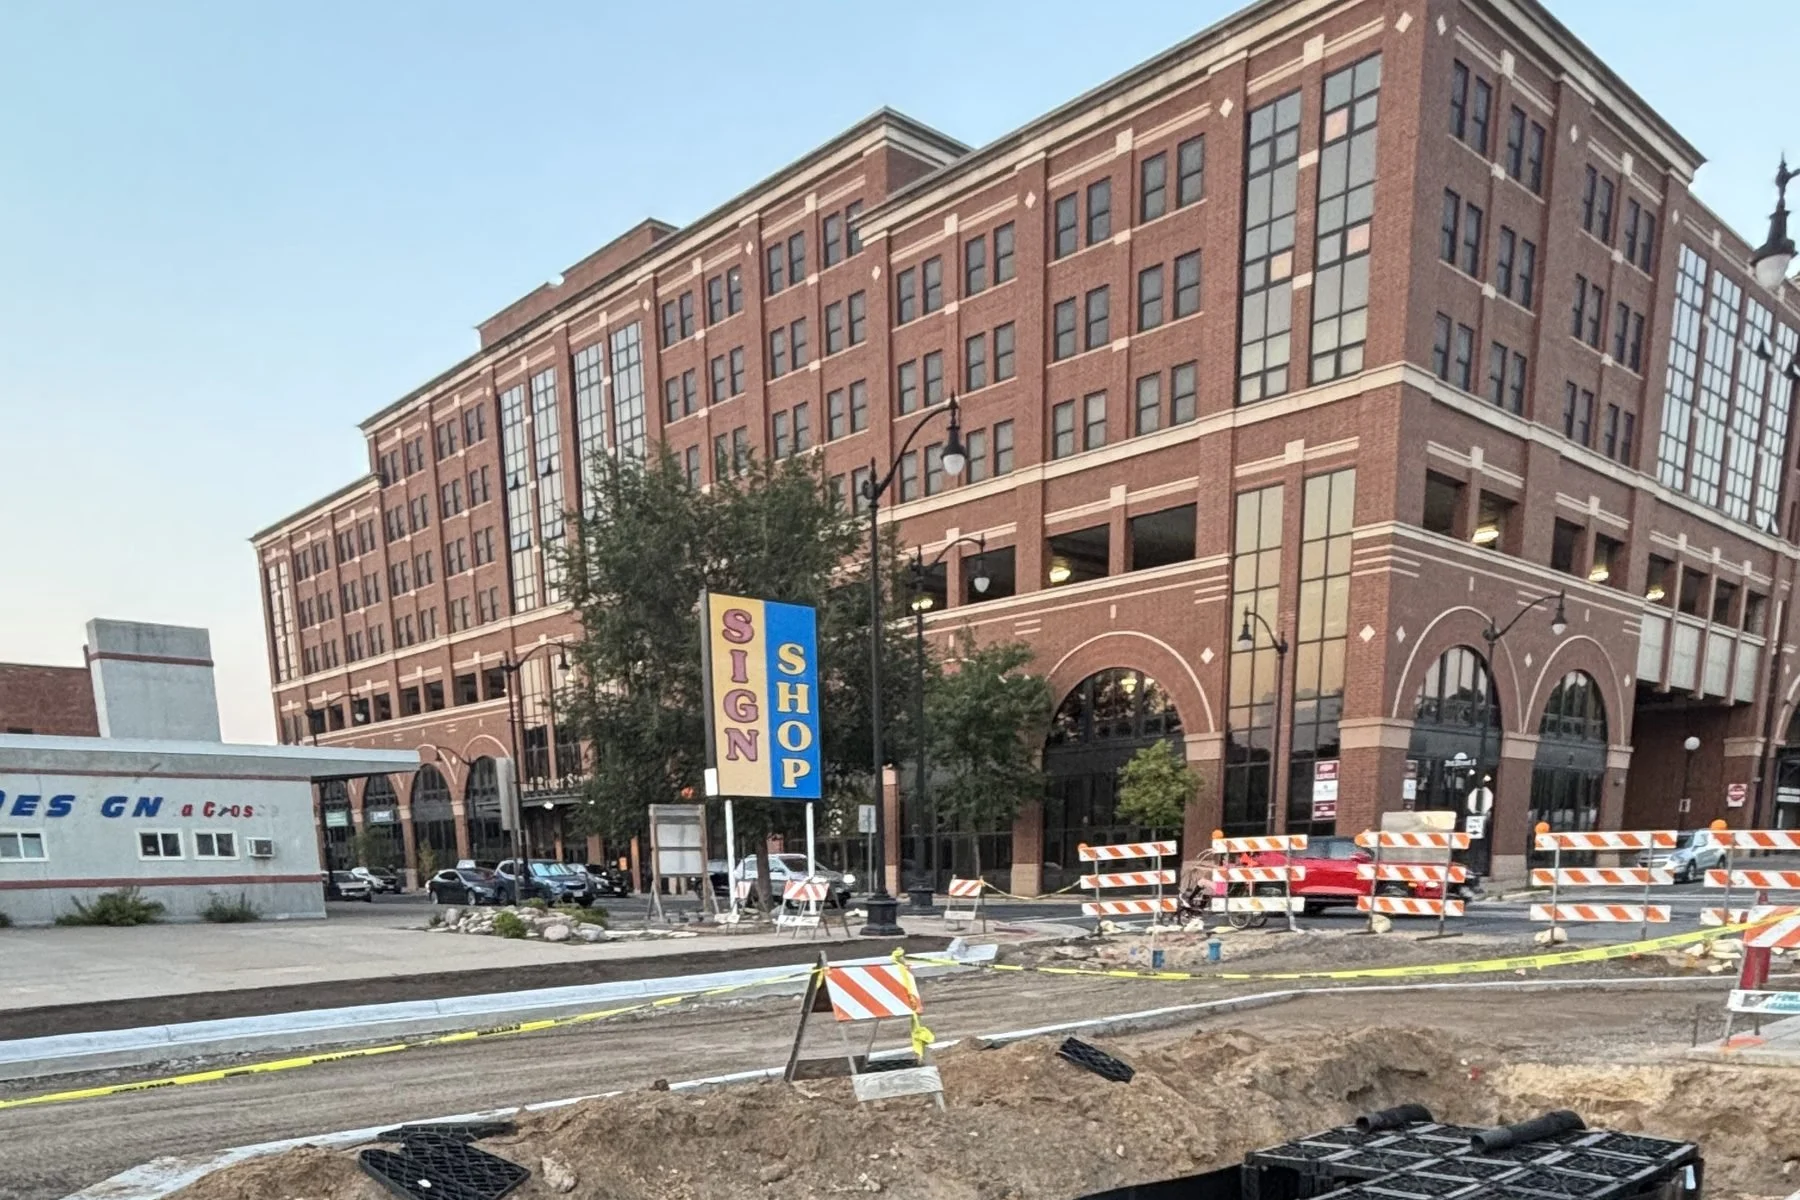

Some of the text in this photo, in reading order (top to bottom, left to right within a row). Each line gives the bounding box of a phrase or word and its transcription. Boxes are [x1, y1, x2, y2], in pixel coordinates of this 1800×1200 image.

[722, 608, 759, 762] SIGN
[777, 643, 812, 789] SHOP
[0, 790, 76, 817] ES
